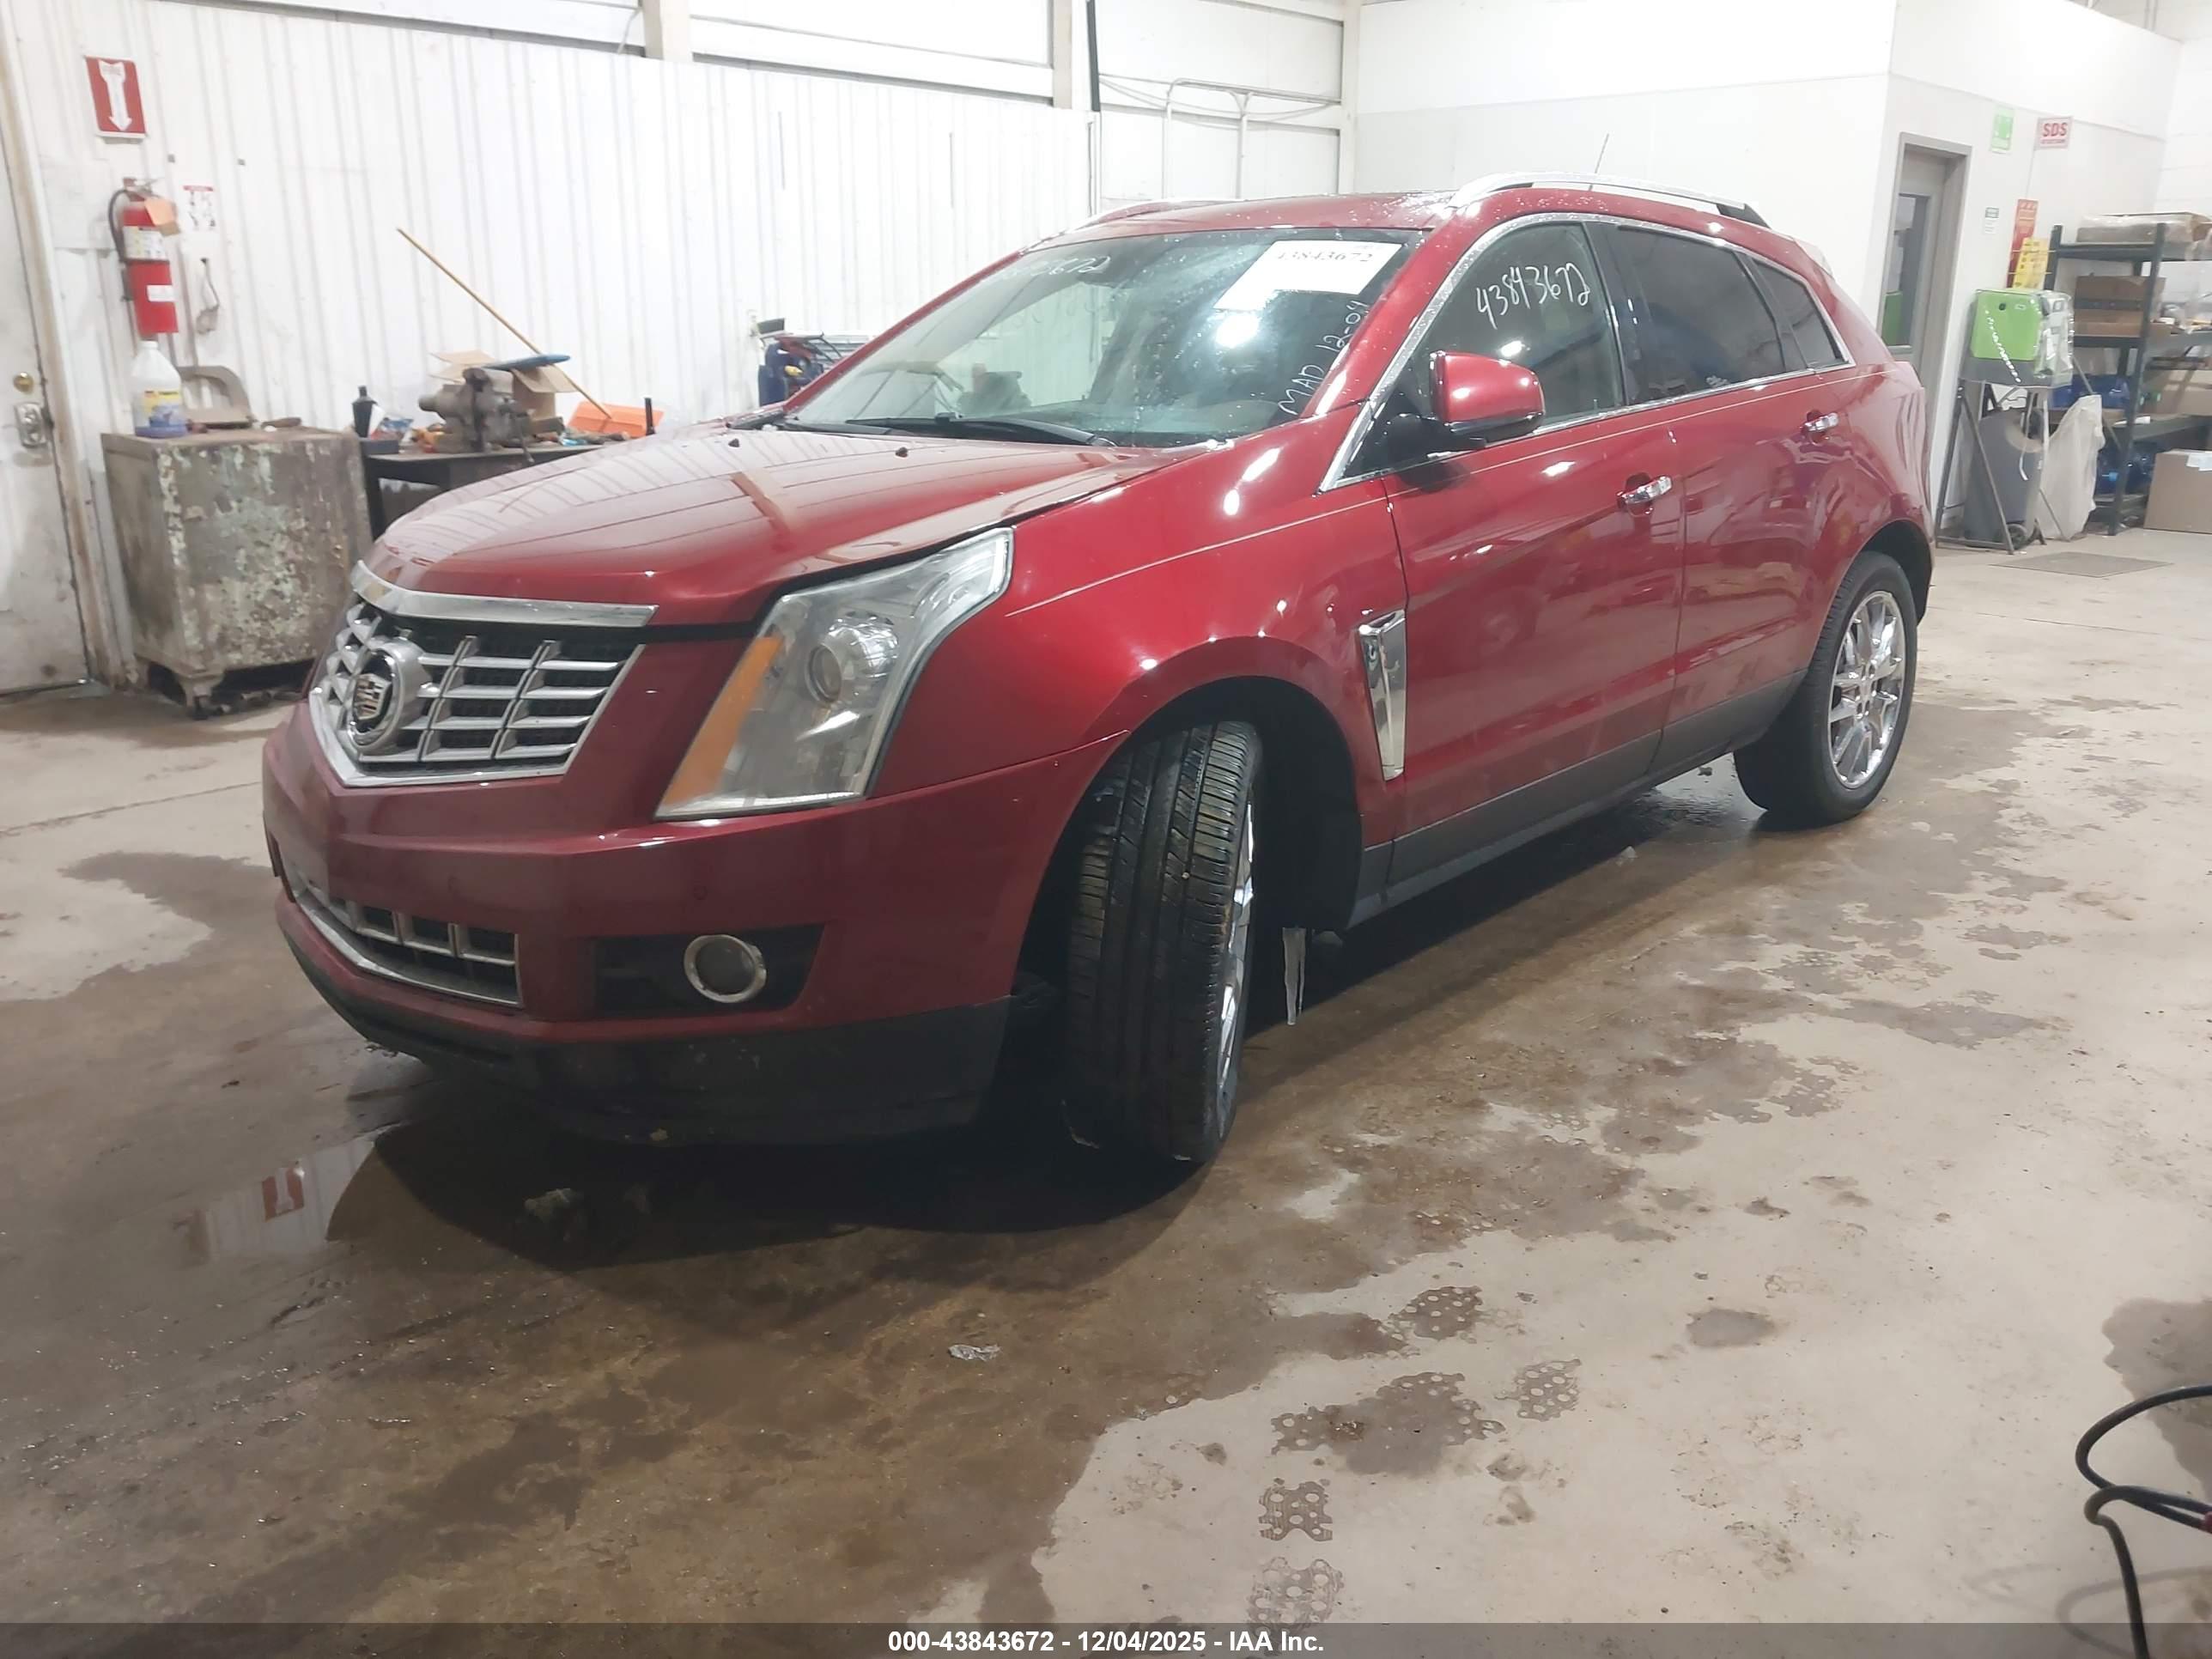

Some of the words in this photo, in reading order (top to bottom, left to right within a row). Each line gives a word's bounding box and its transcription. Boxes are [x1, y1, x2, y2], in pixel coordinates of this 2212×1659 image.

[2042, 122, 2068, 137] SDS
[1476, 262, 1590, 330] 43843672
[1277, 364, 1326, 416] MAD
